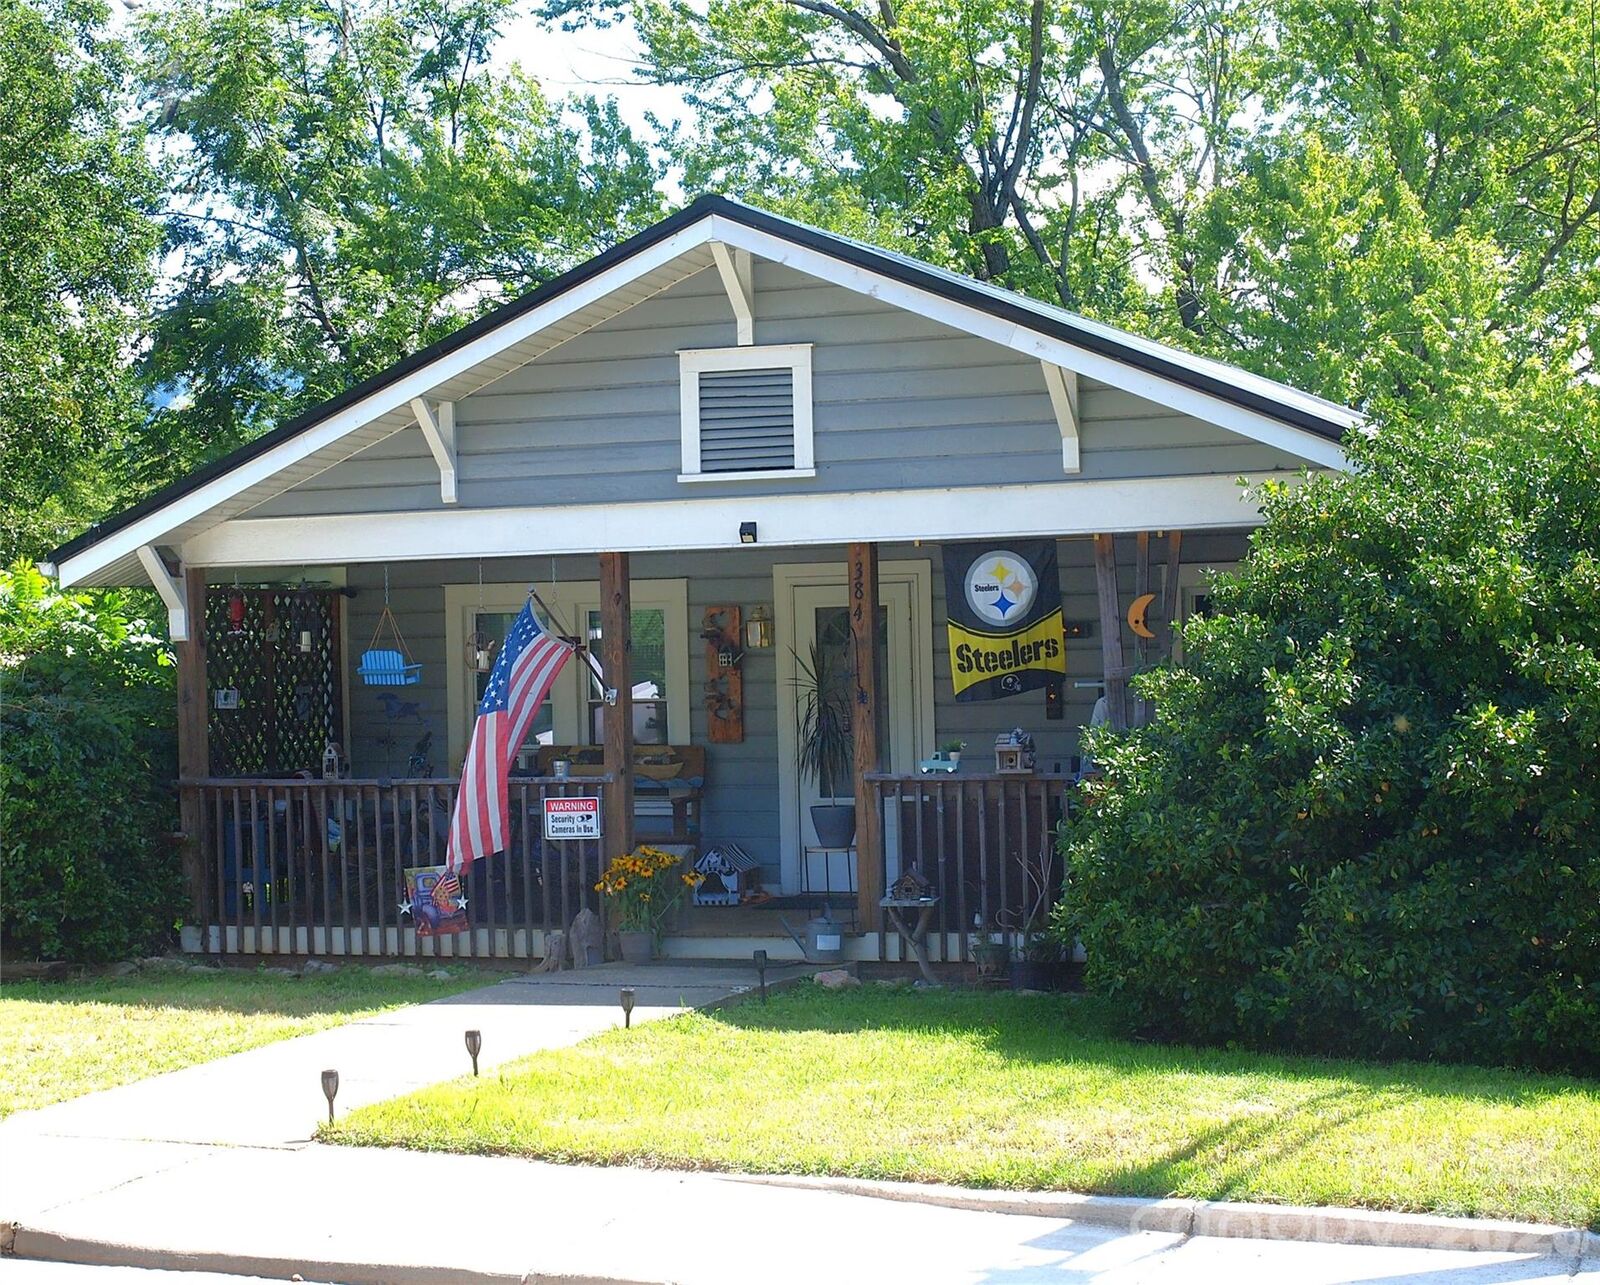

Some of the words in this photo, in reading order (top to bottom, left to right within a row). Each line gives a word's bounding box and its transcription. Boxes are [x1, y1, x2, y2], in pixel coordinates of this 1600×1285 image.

[974, 584, 999, 592] Steelers
[956, 638, 1059, 673] Steelers
[550, 802, 594, 811] WARNING
[551, 814, 575, 824] Security
[551, 824, 575, 833] Cameras
[583, 824, 594, 833] Use
